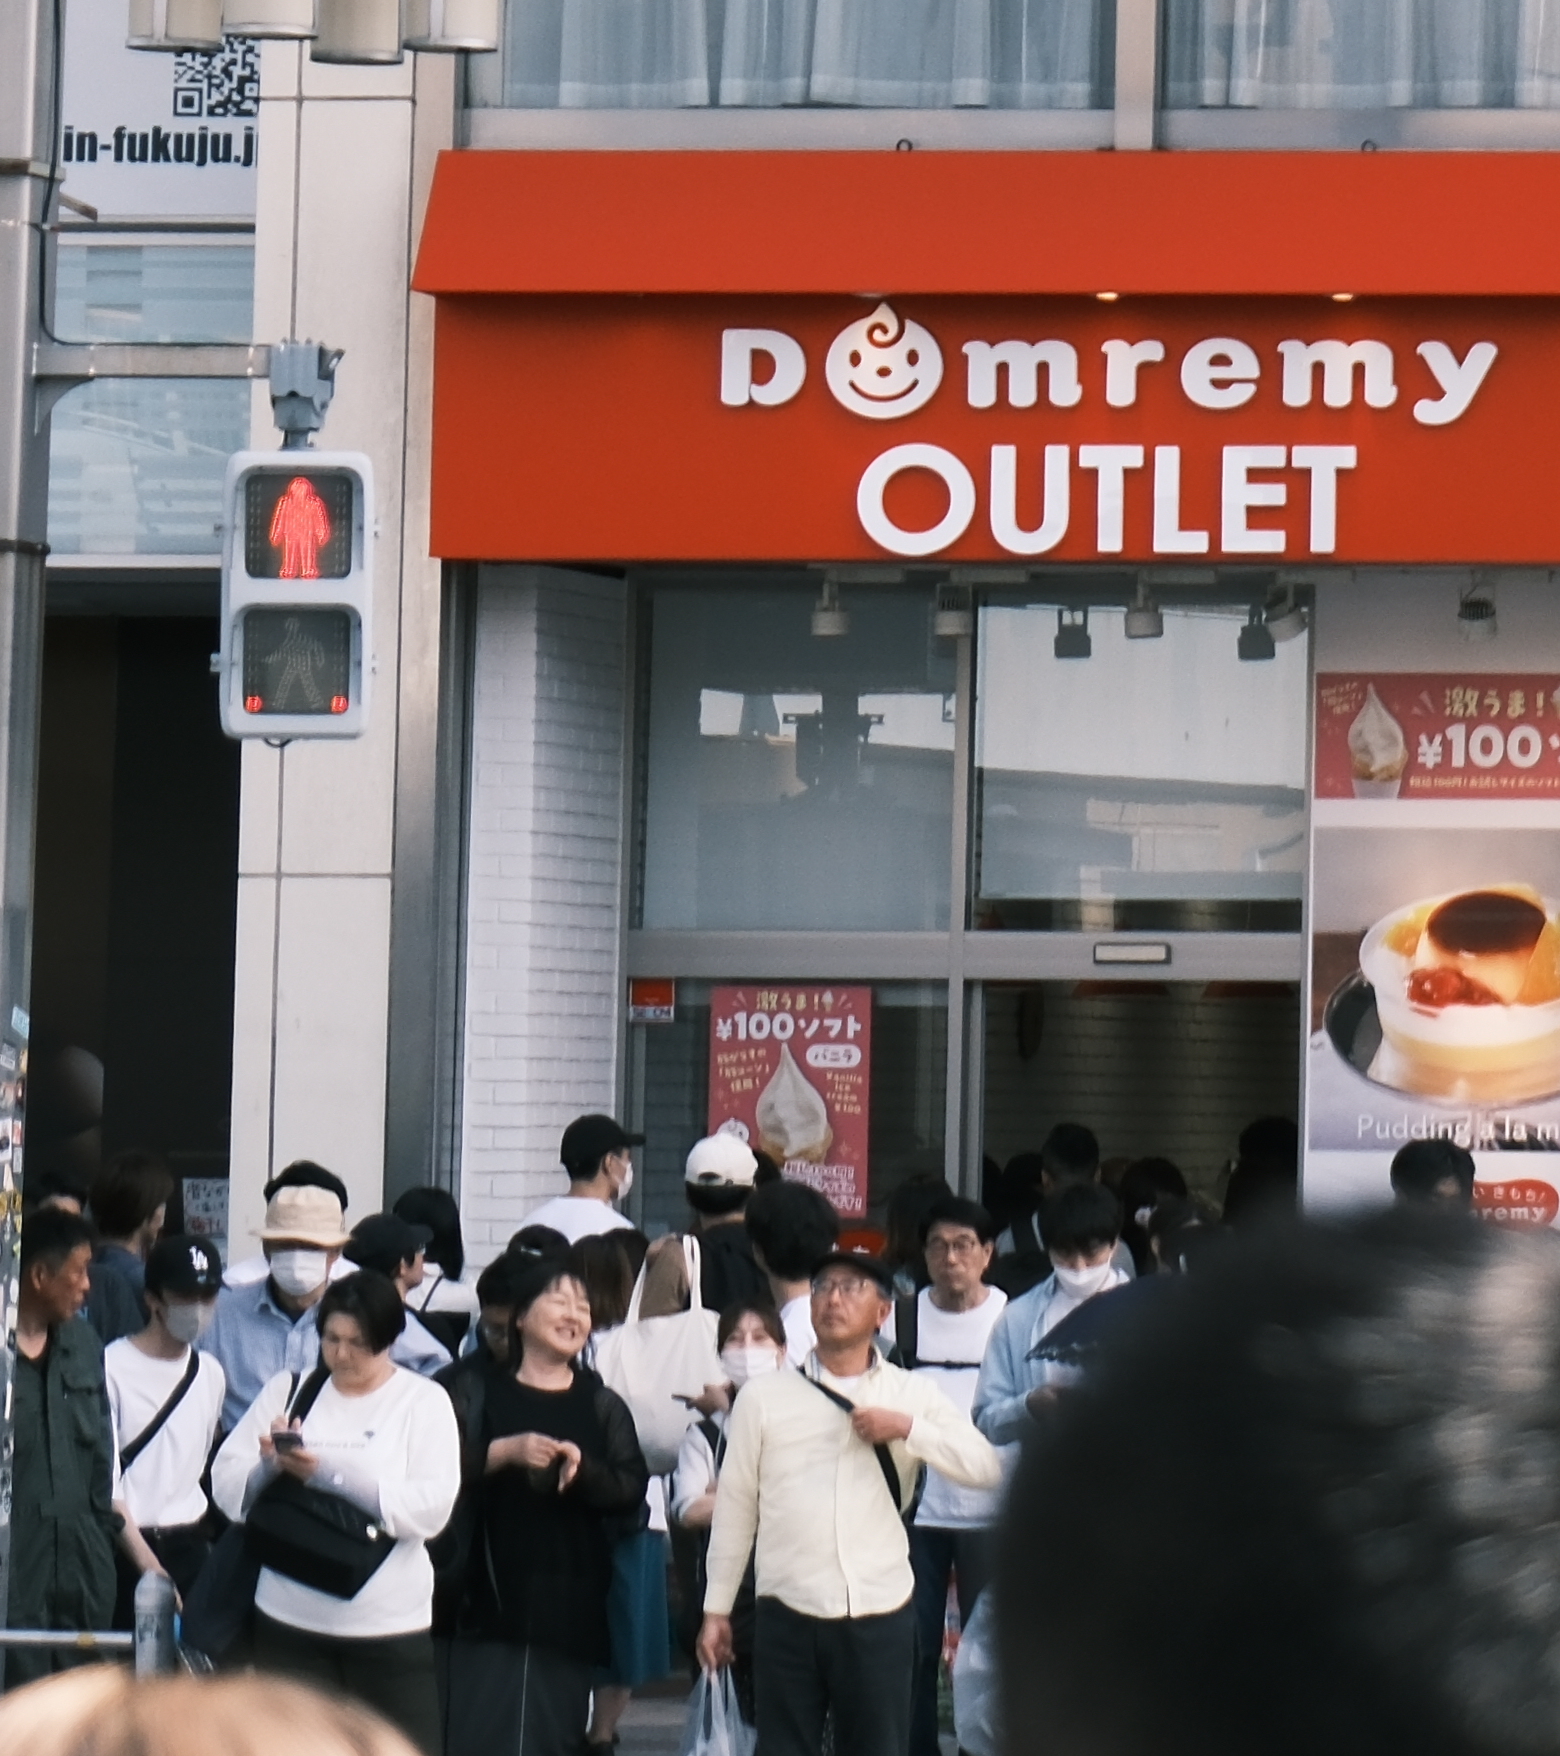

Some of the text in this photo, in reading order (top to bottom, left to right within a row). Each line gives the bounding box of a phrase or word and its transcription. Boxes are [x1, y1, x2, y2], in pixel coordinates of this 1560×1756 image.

[63, 125, 258, 167] in-fukuju.j
[857, 443, 1357, 556] OUTLET
[716, 1011, 862, 1041] ¥100ソフト
[1356, 1113, 1473, 1149] Pudding
[1474, 1206, 1548, 1228] remy
